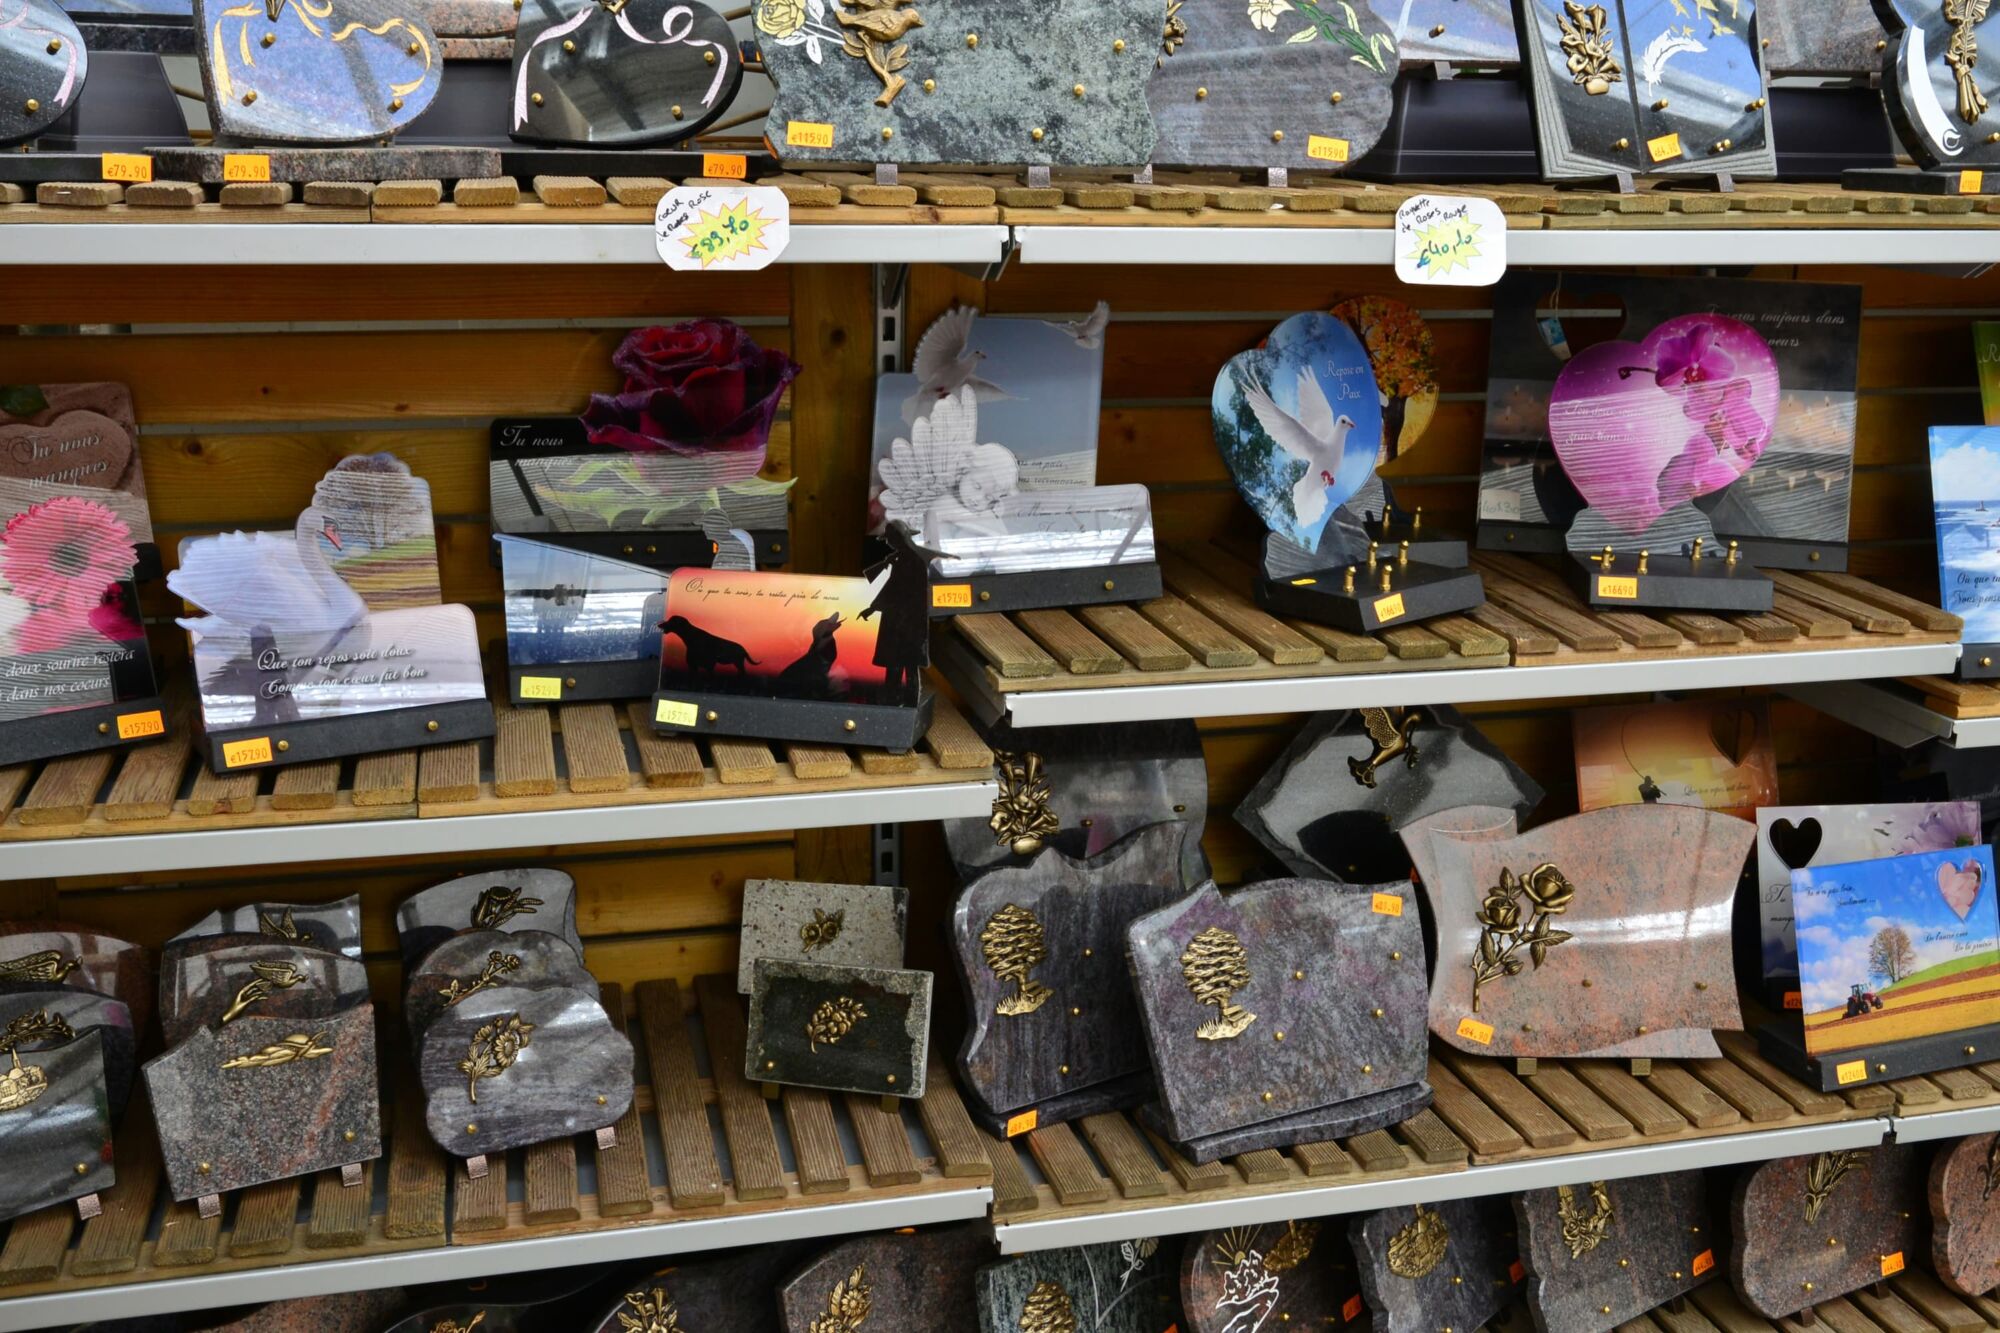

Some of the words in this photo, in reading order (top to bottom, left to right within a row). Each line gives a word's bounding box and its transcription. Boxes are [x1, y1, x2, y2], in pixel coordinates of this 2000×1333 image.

[107, 164, 147, 179] €79.90
[228, 165, 266, 178] €79.90
[708, 165, 743, 175] €79.90
[1760, 312, 1811, 328] toujours
[1815, 310, 1845, 324] dans
[60, 434, 101, 453] nous
[500, 425, 531, 446] Tu
[532, 438, 564, 446] nous
[29, 461, 109, 488] manques
[257, 648, 288, 670] Que
[292, 658, 313, 668] ton
[318, 655, 350, 669] repos
[353, 649, 377, 660] soit
[381, 644, 414, 656] doux
[403, 664, 426, 678] bon
[6, 686, 40, 702] dans
[45, 683, 66, 696] nos
